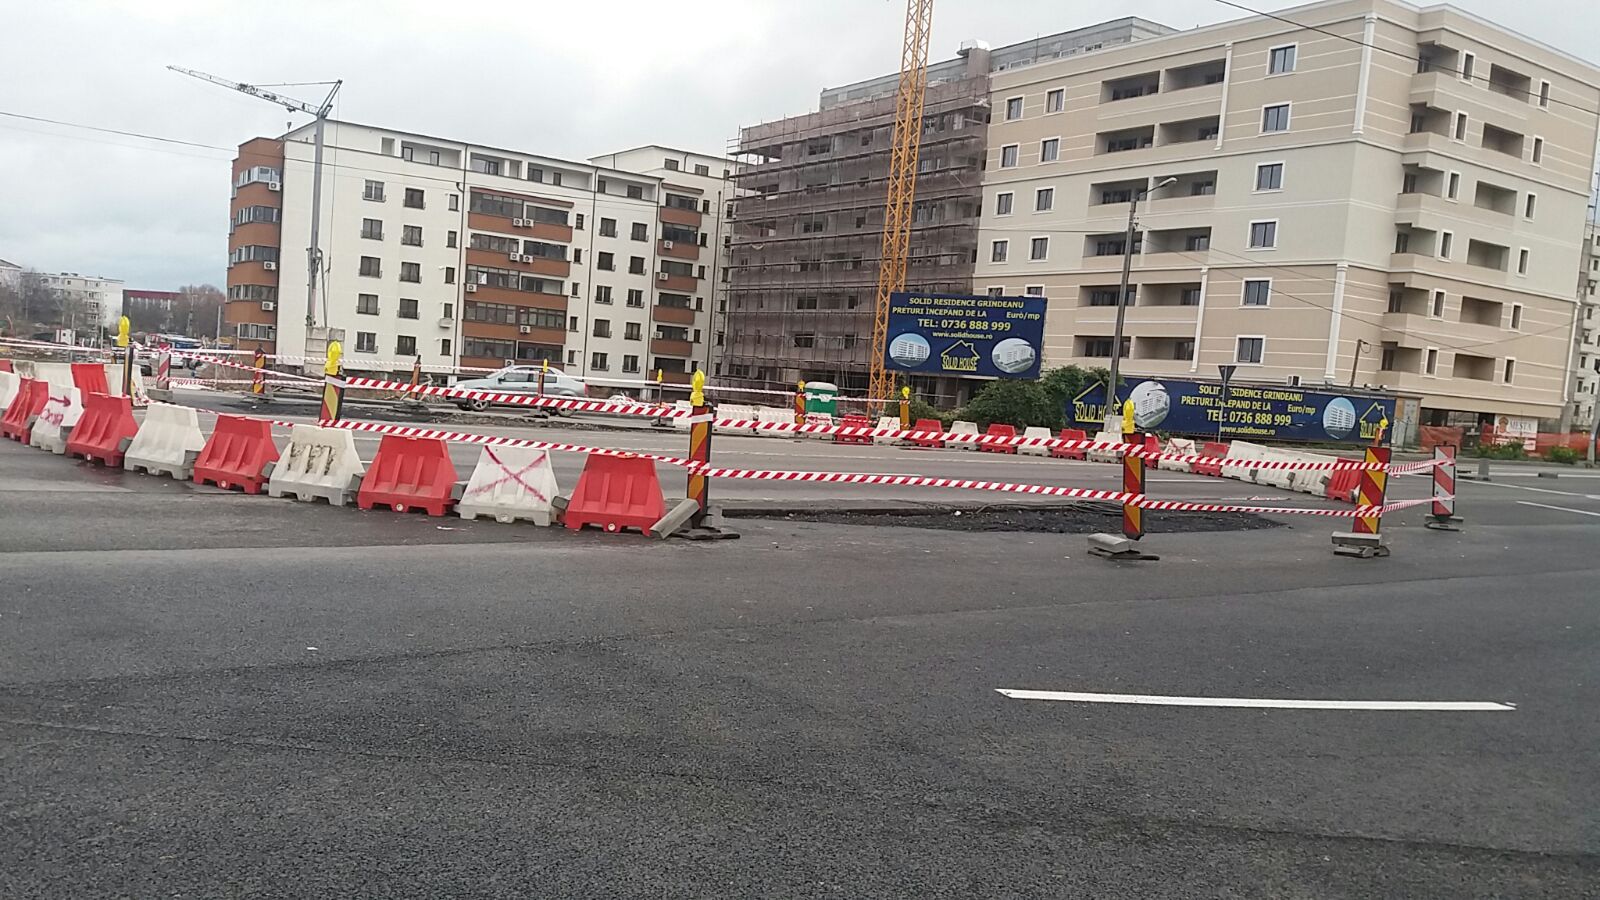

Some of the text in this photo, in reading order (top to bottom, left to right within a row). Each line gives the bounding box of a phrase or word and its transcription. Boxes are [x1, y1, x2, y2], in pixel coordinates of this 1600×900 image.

[909, 297, 1024, 309] SOLID RESIDENCE GRINDEANU
[892, 307, 924, 315] PRETURI
[925, 308, 964, 317] INCEPAND
[977, 310, 987, 318] LA
[1006, 311, 1040, 321] Euro/mp
[917, 318, 1011, 332] TEL: 0736 888 999
[932, 331, 993, 340] www.solidhouse.ro
[942, 355, 977, 370] SOLID HOUSE
[1229, 387, 1262, 399] SIDENCE
[1262, 390, 1303, 402] GRINDEANU
[1075, 403, 1096, 420] SOLID
[1181, 395, 1213, 407] PRETURI
[1251, 401, 1262, 410] DE
[1262, 402, 1271, 411] LA
[1287, 404, 1316, 415] Euro/mp
[1207, 409, 1292, 426] TEL: 0736 888 999
[1220, 425, 1276, 436] www.solidhouse.ro
